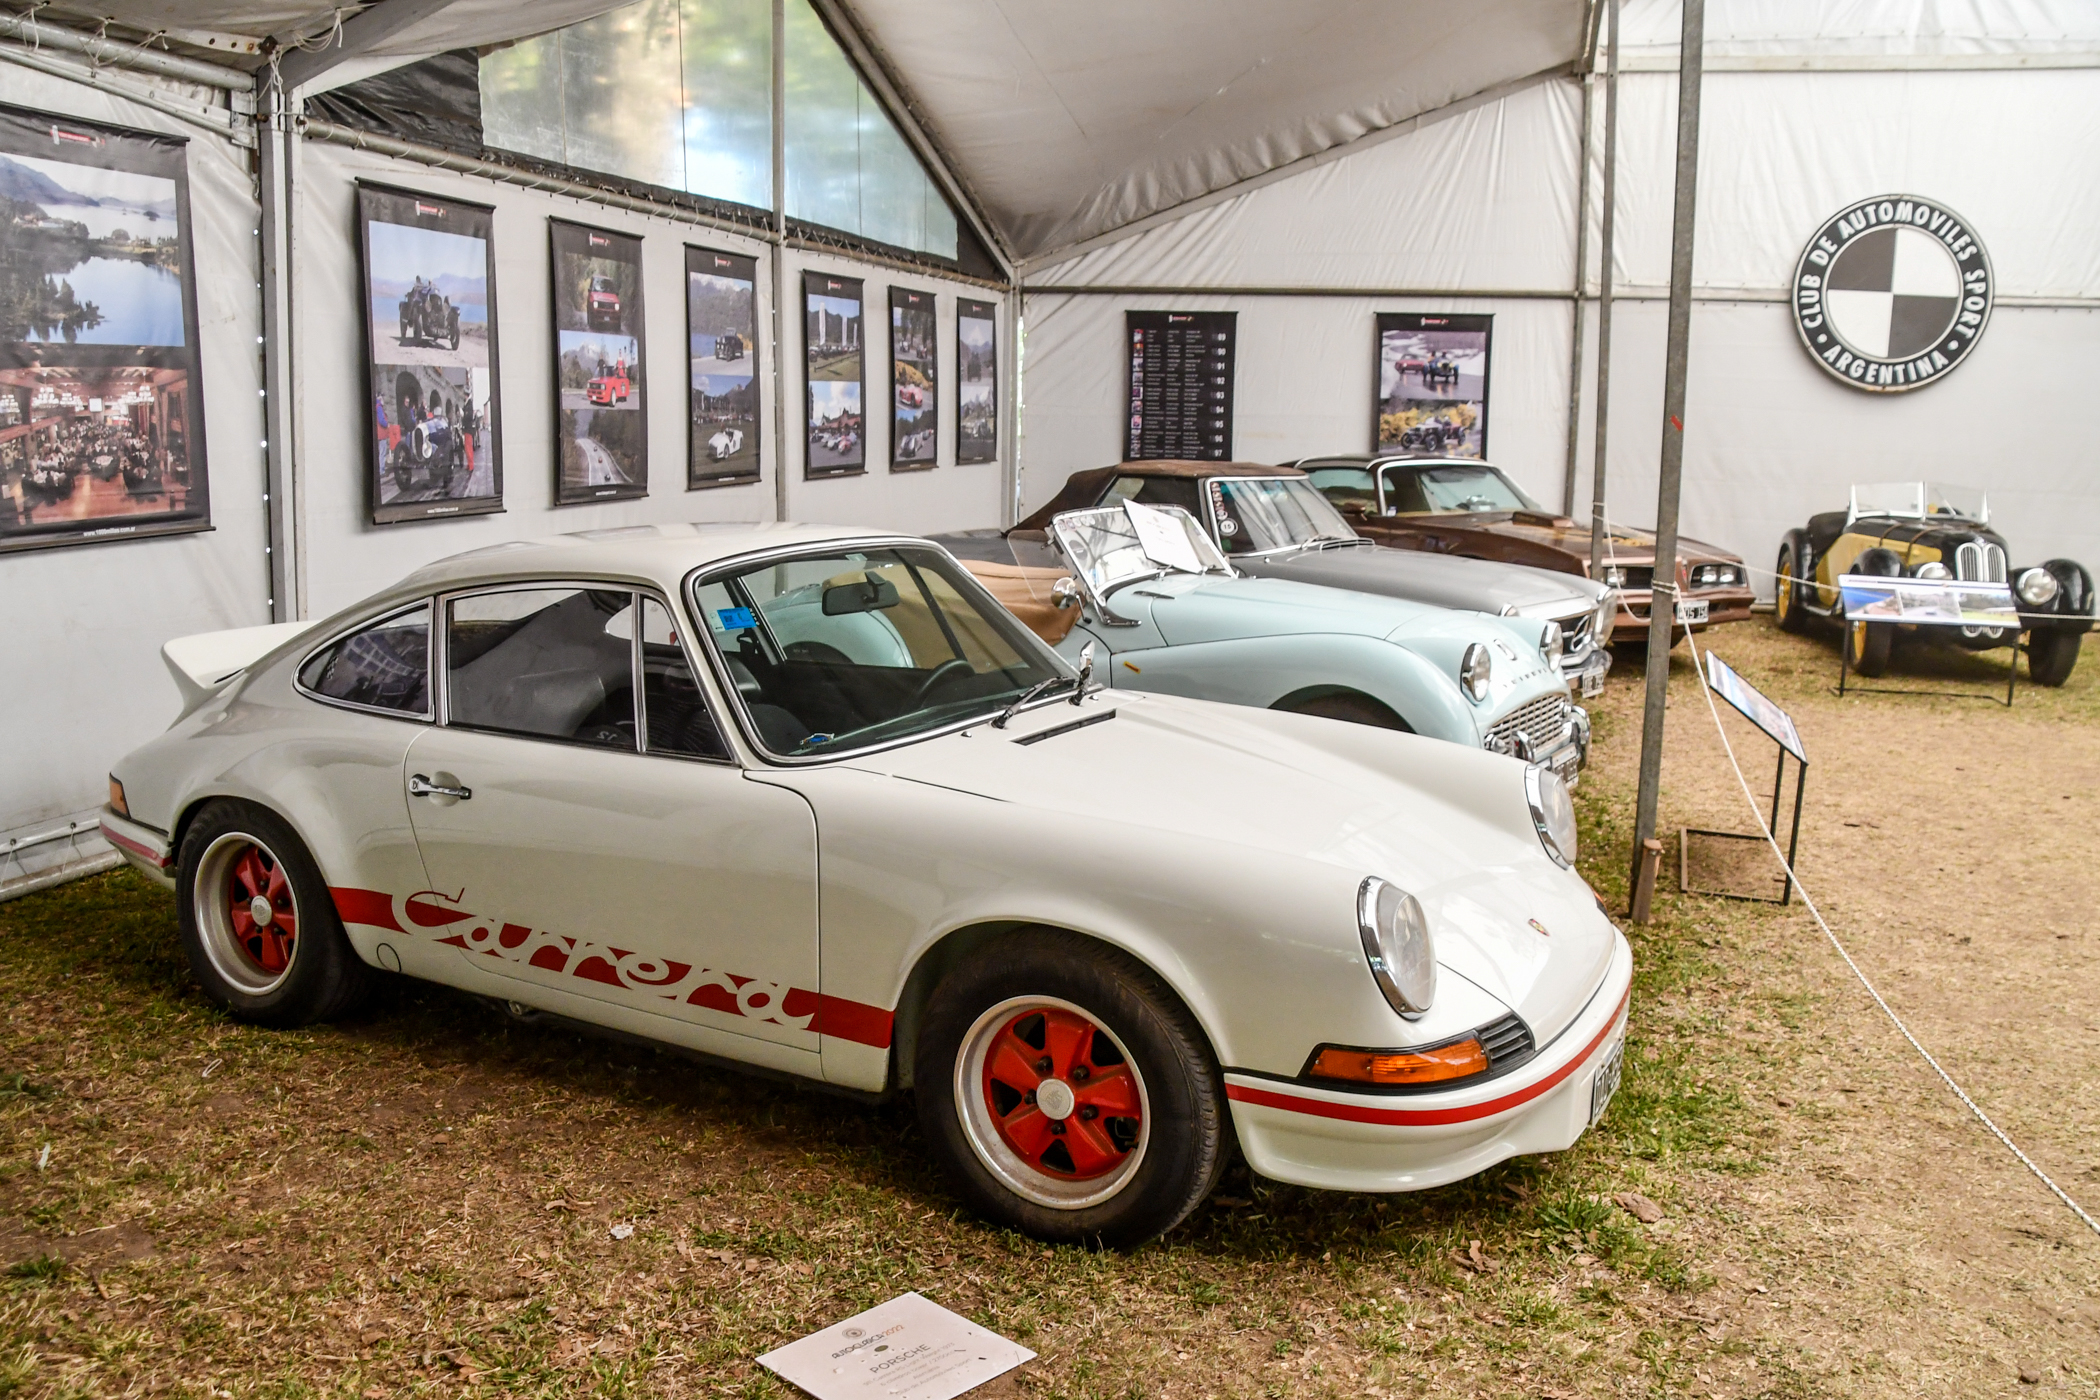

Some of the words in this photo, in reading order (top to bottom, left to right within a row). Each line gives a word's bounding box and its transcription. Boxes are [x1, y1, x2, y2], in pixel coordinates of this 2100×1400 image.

[1808, 235, 1838, 267] DE
[1836, 201, 1978, 262] AUTOMOVILES
[1798, 273, 1824, 329] CLUB
[1954, 268, 1987, 340] SPORT
[1822, 344, 1949, 385] ARGENTINA
[392, 887, 818, 1030] Carrera
[869, 1344, 931, 1373] PORSCHE
